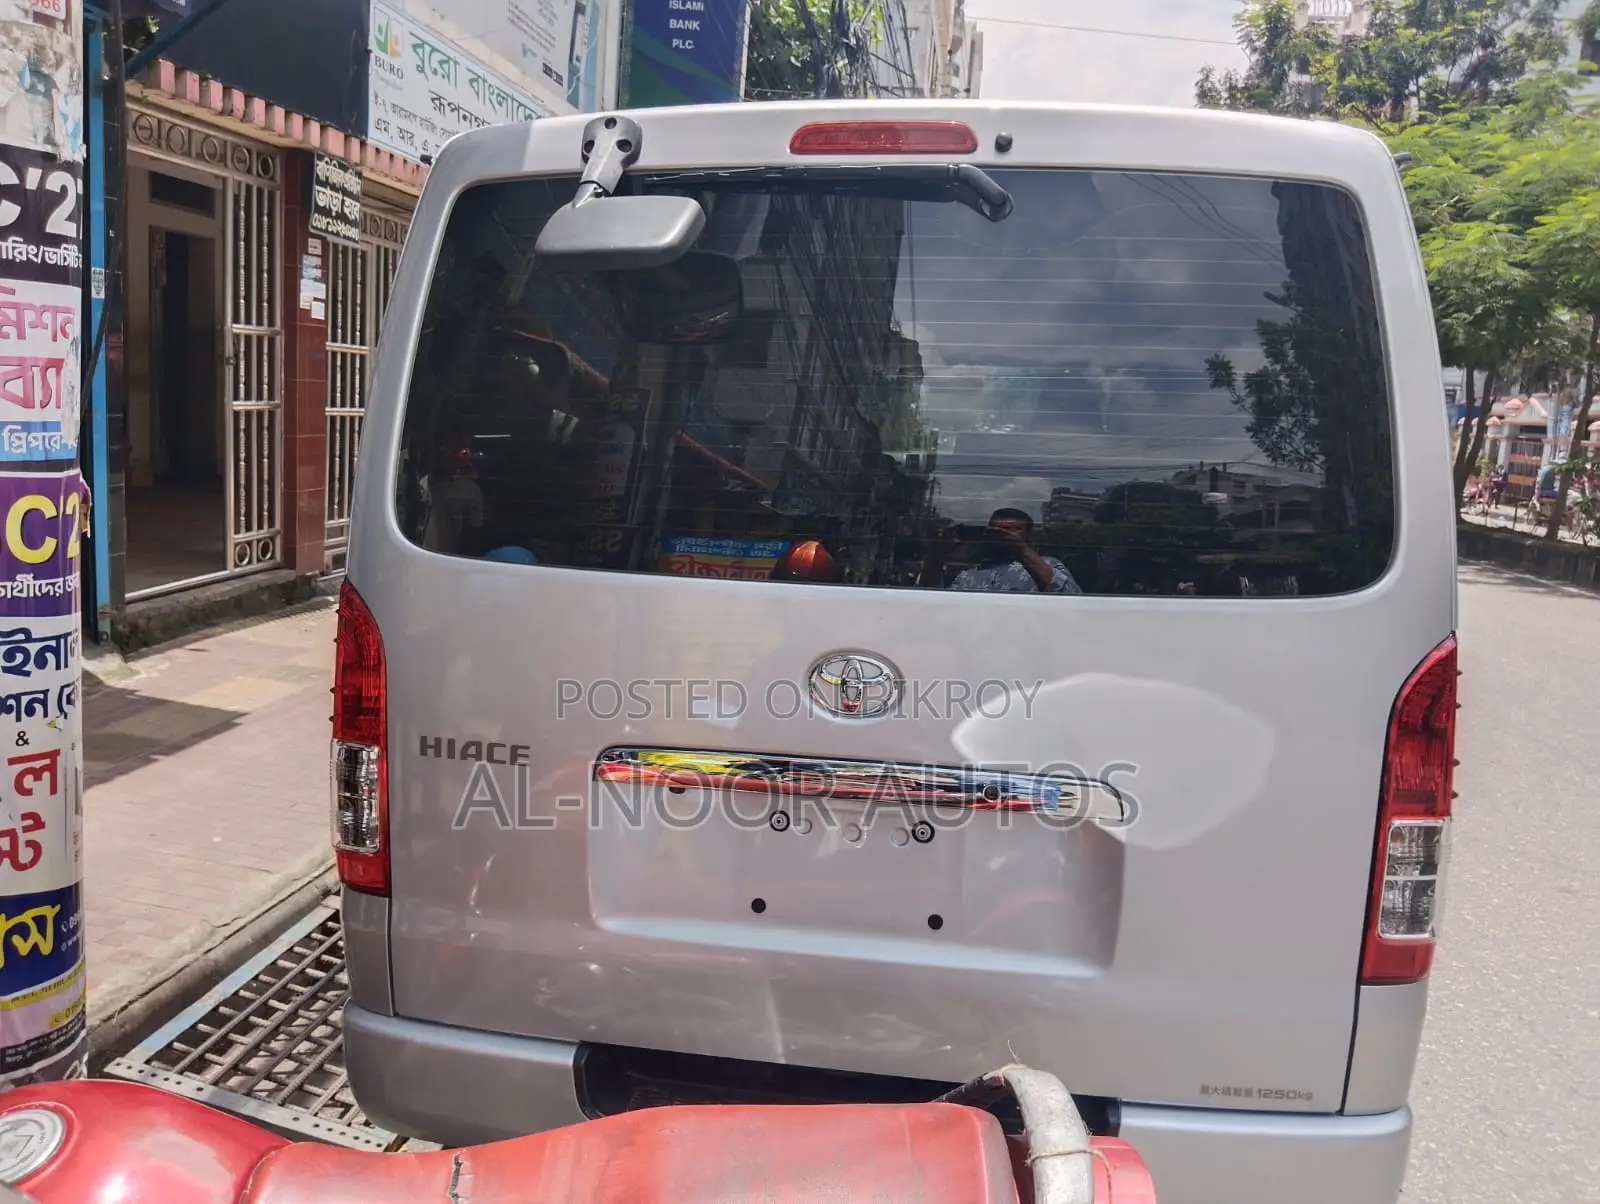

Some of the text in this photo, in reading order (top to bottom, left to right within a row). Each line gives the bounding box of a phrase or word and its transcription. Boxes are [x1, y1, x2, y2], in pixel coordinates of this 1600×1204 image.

[668, 0, 705, 11] ISLAMI
[669, 18, 700, 31] BANK
[374, 55, 404, 80] BURO
[408, 30, 460, 90] বুরো
[466, 66, 545, 123] বাংলাদে
[428, 89, 492, 129] রূপনগ
[15, 730, 29, 747] &
[419, 735, 531, 766] HIACE
[1257, 1088, 1314, 1101] 1250kg
